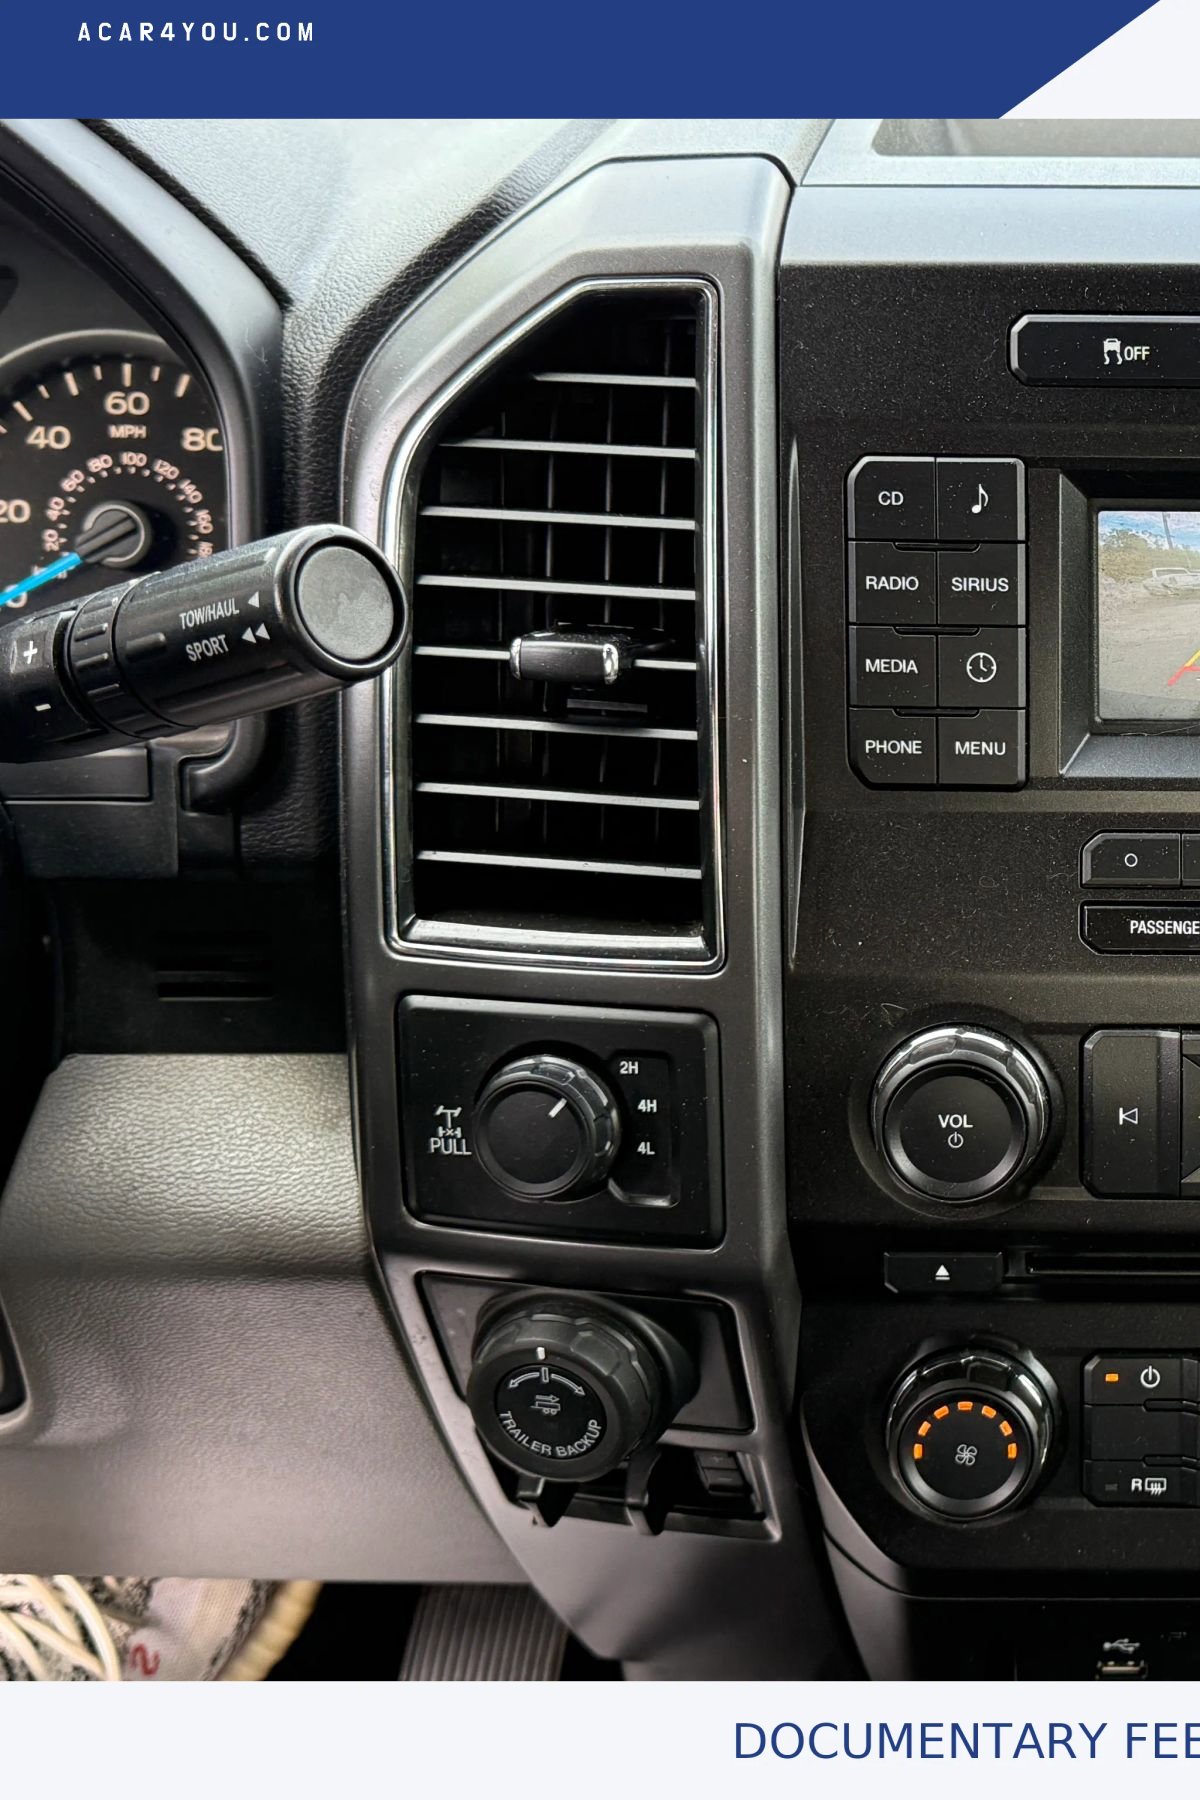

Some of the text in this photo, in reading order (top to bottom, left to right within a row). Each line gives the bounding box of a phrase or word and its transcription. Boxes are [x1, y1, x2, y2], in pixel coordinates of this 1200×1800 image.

[1123, 345, 1150, 361] OFF
[104, 391, 150, 415] 60
[26, 425, 71, 450] 40
[108, 424, 147, 439] MPH
[181, 427, 223, 451] 80
[86, 454, 113, 473] 80
[120, 452, 147, 467] 100
[153, 459, 180, 480] 120
[60, 469, 85, 492] 60
[878, 490, 904, 506] CD
[865, 575, 919, 591] RADIO
[951, 576, 1009, 592] SIRIUS
[179, 597, 240, 630] TOW/HAUL
[185, 633, 229, 662] SPORT
[865, 658, 919, 674] MEDIA
[865, 739, 924, 755] PHONE
[955, 741, 1007, 757] MENU
[619, 1060, 640, 1076] 2H
[637, 1099, 658, 1113] 4H
[938, 1114, 974, 1129] VOL
[429, 1137, 472, 1156] PULL
[637, 1141, 656, 1155] 4L
[499, 1410, 602, 1457] TRAILER BACKUP
[1131, 1478, 1143, 1492] R
